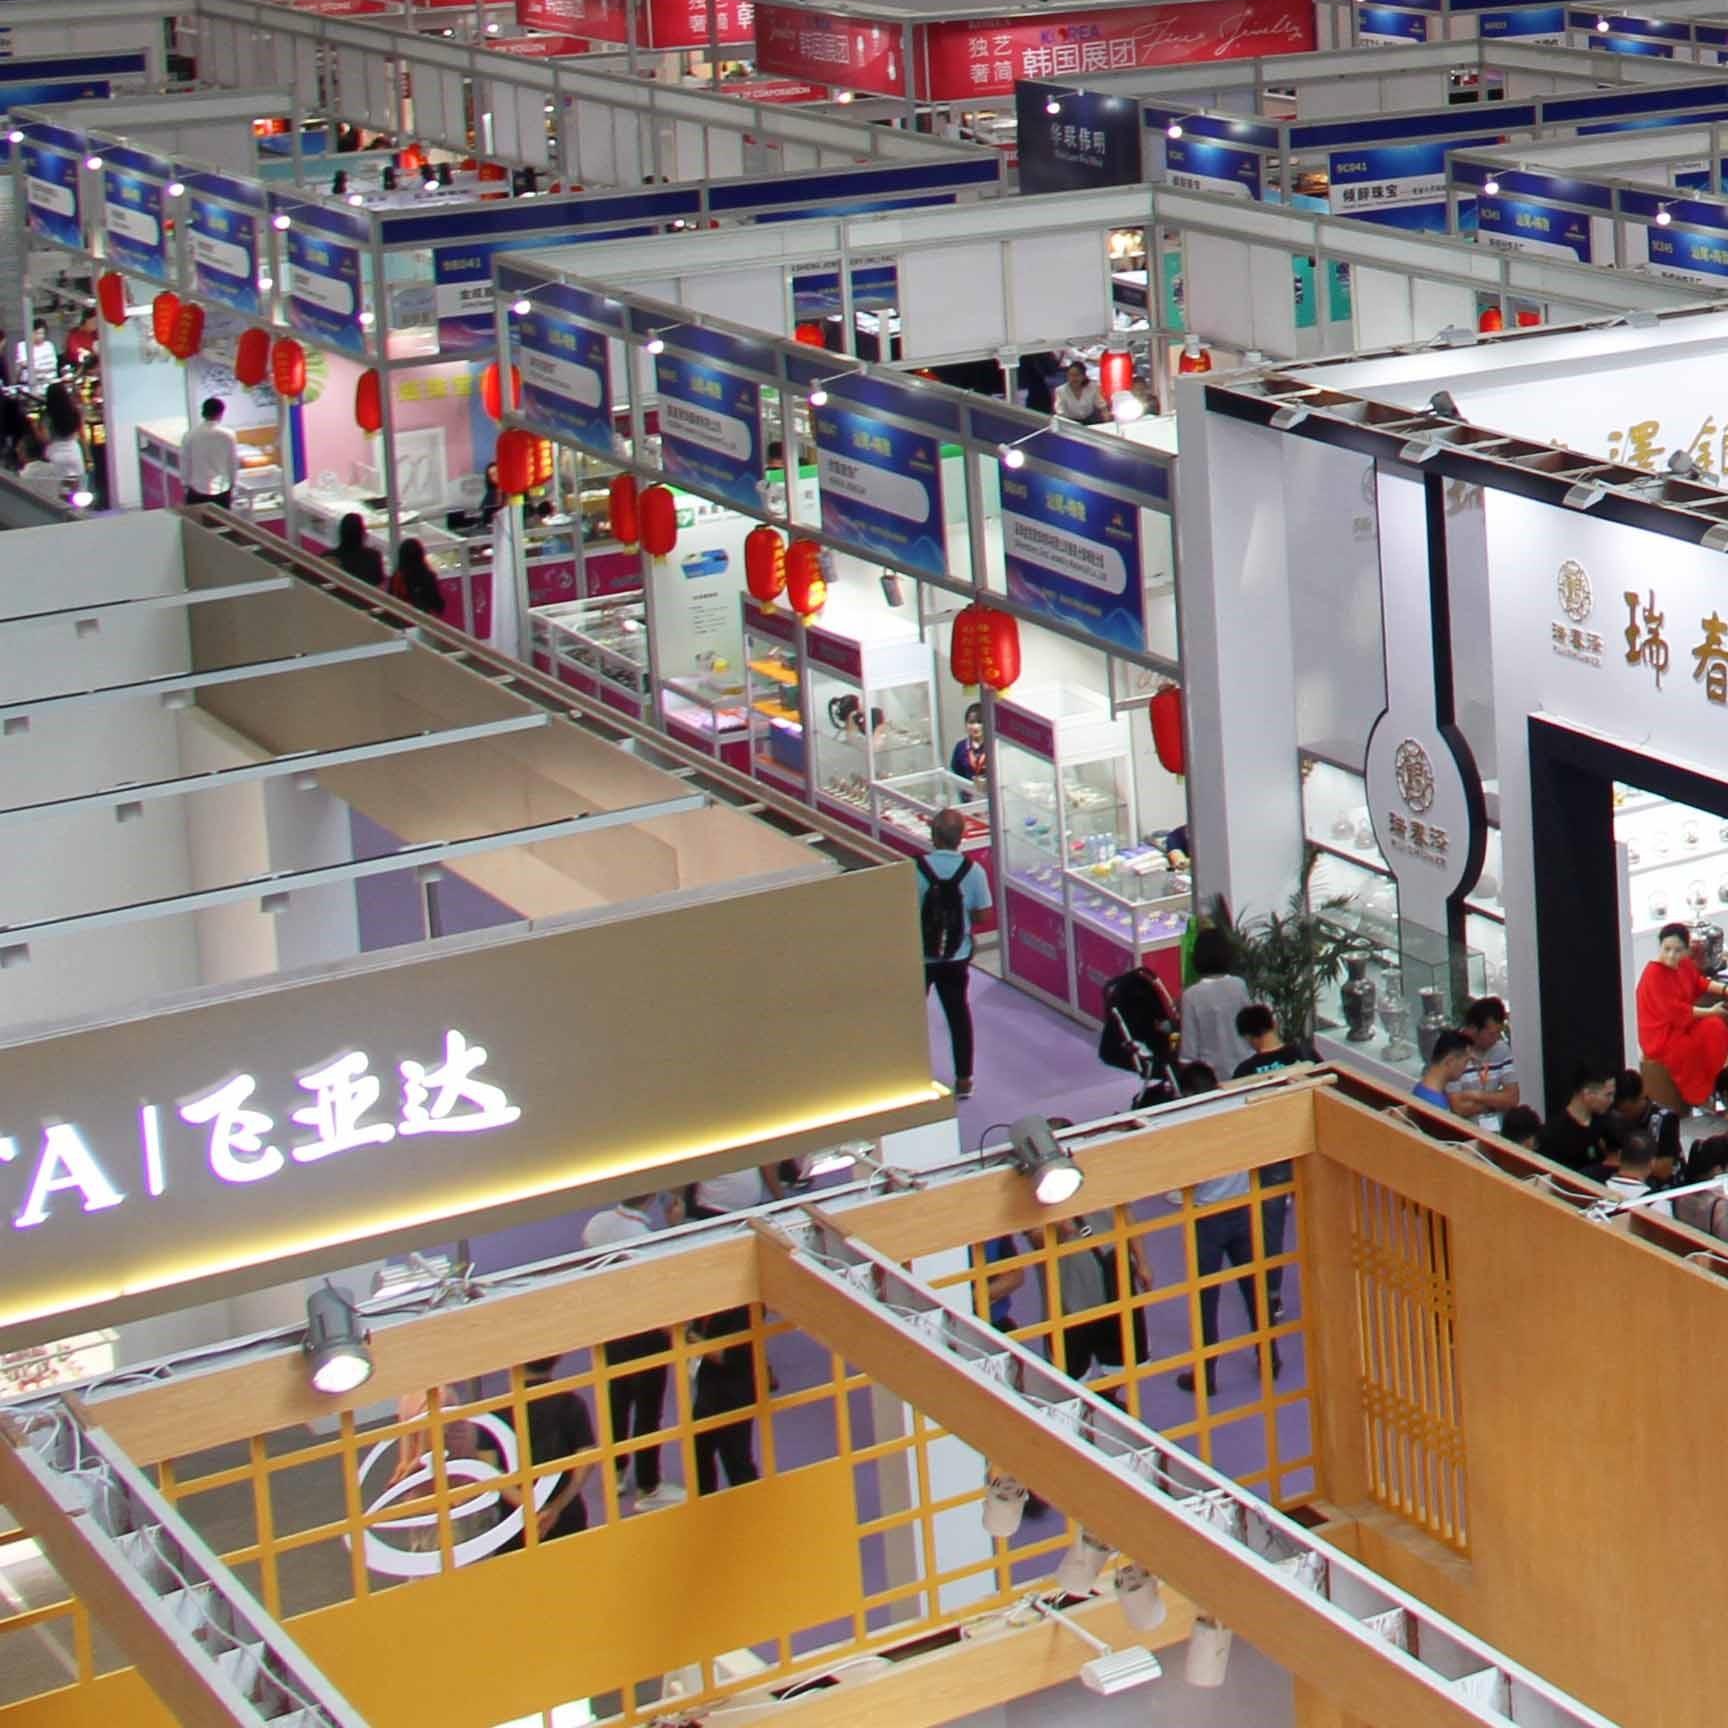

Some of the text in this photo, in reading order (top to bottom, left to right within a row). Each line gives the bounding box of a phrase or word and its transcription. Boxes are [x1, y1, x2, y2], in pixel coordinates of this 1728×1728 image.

[1022, 37, 1137, 79] 韩国展团
[180, 1028, 522, 1184] 飞亚达
[0, 1118, 126, 1229] A
